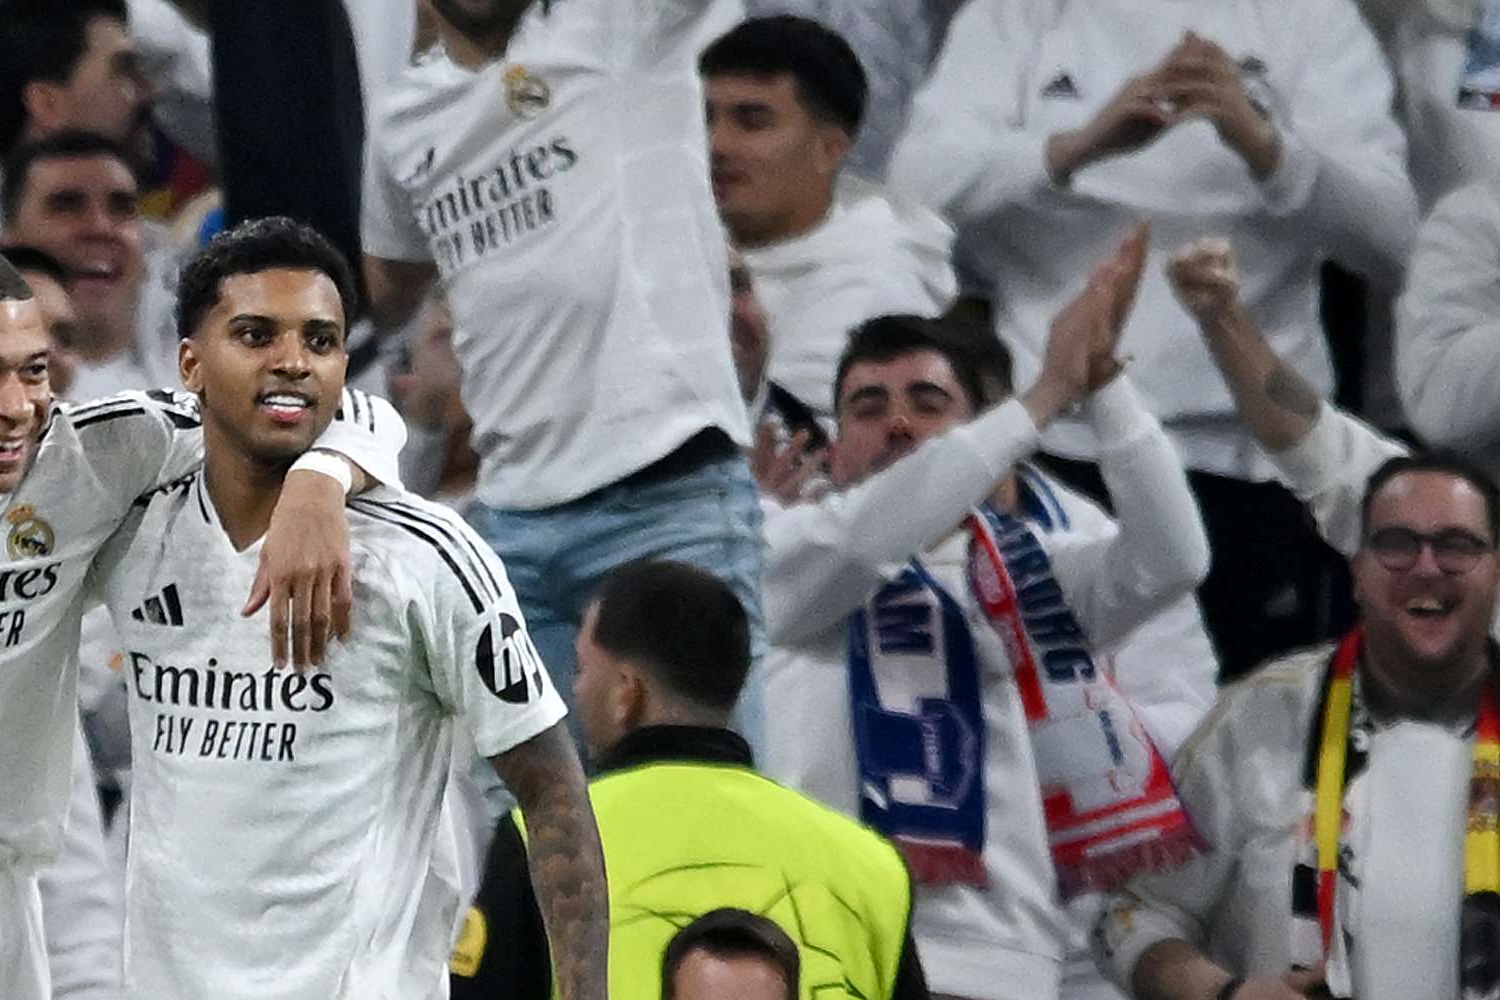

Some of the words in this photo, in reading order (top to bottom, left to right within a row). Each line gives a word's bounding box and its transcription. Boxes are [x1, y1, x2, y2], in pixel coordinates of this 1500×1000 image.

[425, 136, 579, 237] mirates
[129, 650, 335, 713] Emirates
[153, 713, 194, 755] FLY
[199, 719, 297, 762] BETTER
